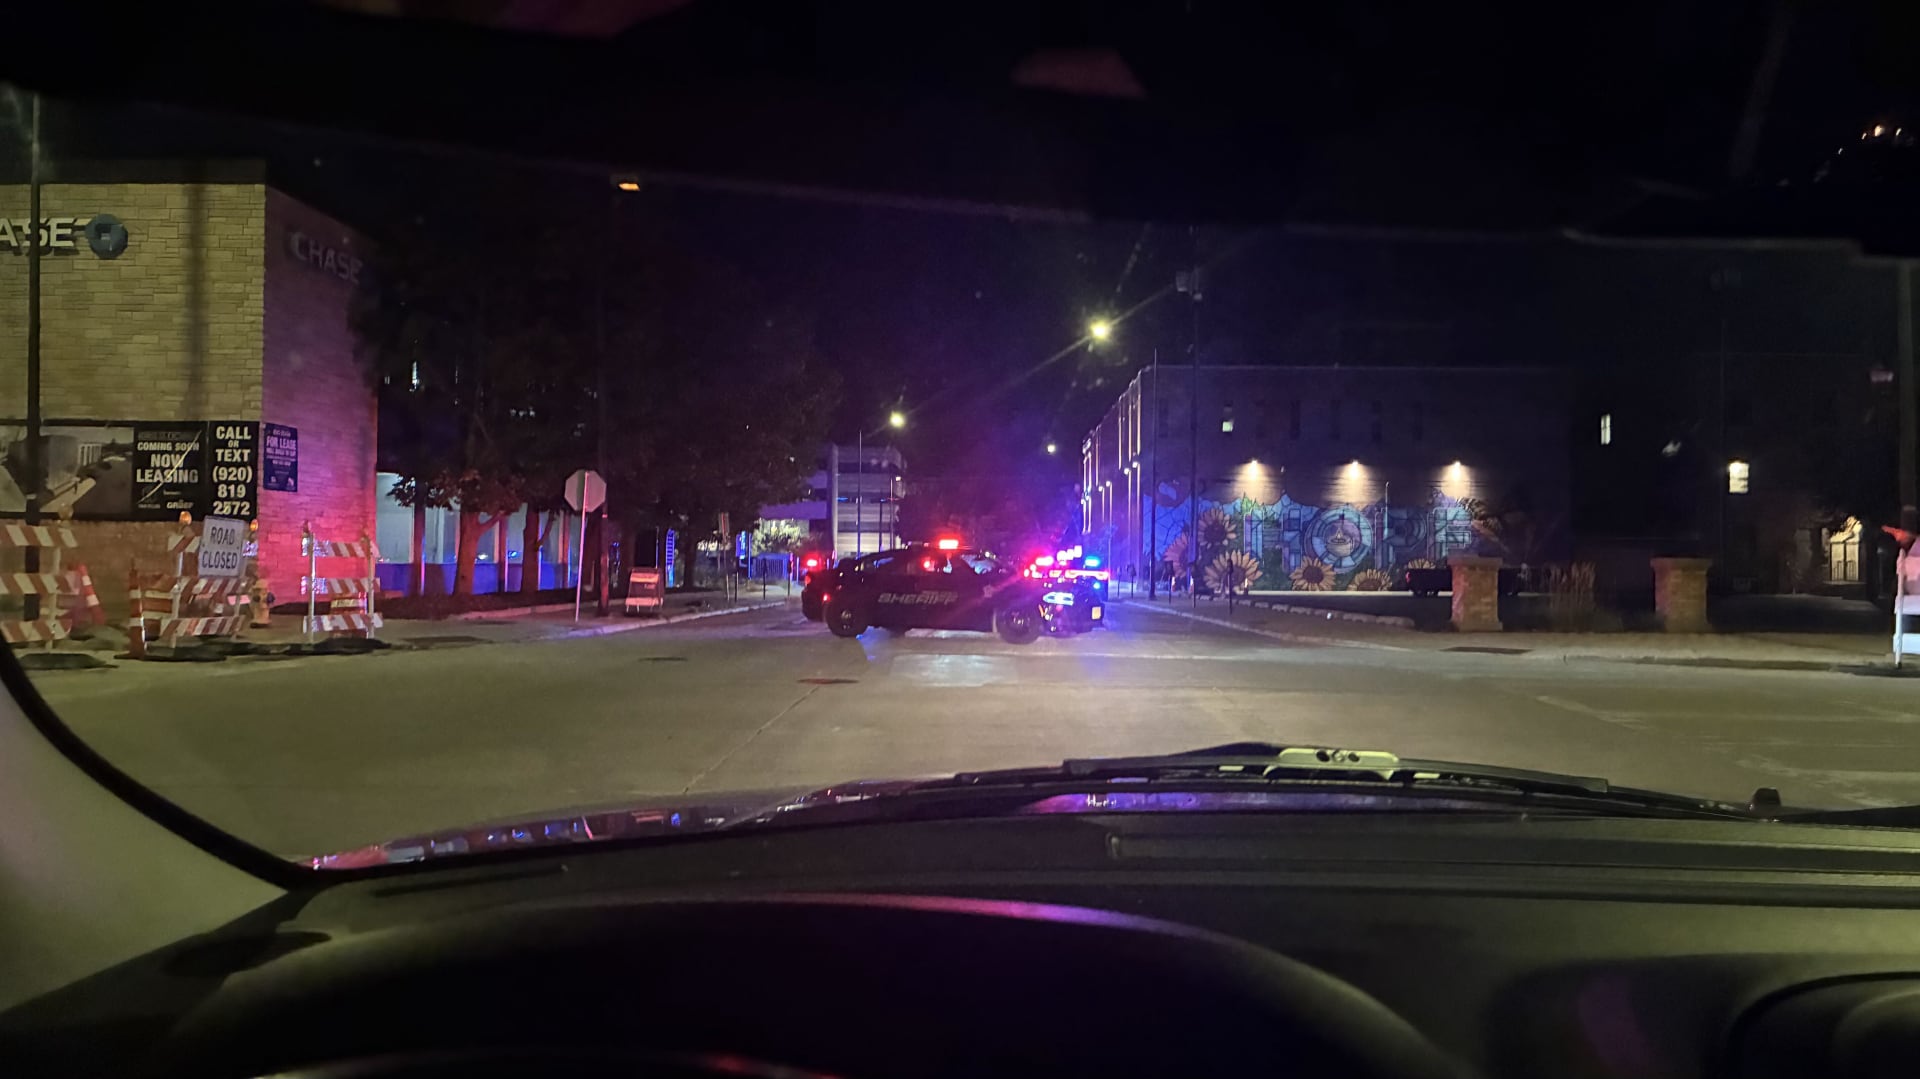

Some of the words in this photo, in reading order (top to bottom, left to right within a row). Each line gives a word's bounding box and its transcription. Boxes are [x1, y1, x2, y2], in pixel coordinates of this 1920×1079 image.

[291, 231, 363, 286] CHASE
[216, 426, 251, 439] CALL
[137, 441, 172, 451] COMING
[228, 440, 239, 448] OR
[266, 435, 279, 448] FOR
[279, 437, 297, 450] LEASE
[150, 453, 184, 468] NOW
[215, 449, 250, 462] TEXT
[136, 469, 199, 483] LEASING
[212, 466, 253, 483] (920)
[217, 484, 246, 498] 819
[213, 501, 250, 515] 2572
[210, 526, 236, 545] ROAD
[1243, 503, 1471, 575] HOPE
[201, 550, 238, 569] CLOSED
[878, 592, 958, 606] SHERIFF
